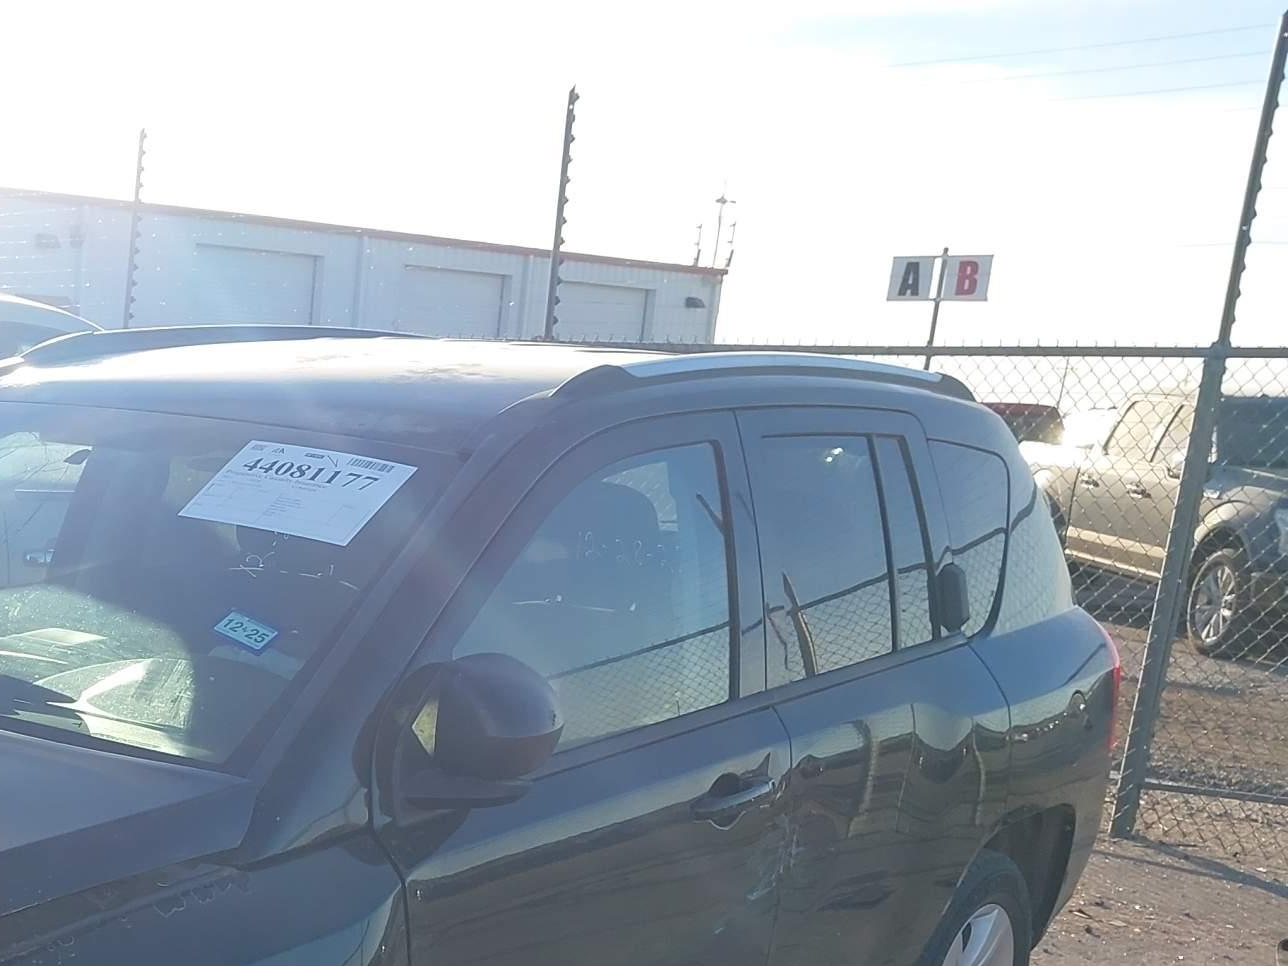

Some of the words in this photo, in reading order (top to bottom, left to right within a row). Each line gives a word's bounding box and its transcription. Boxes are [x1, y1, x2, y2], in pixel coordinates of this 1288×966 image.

[898, 261, 920, 296] A
[955, 260, 979, 296] B
[242, 457, 381, 491] 44081177
